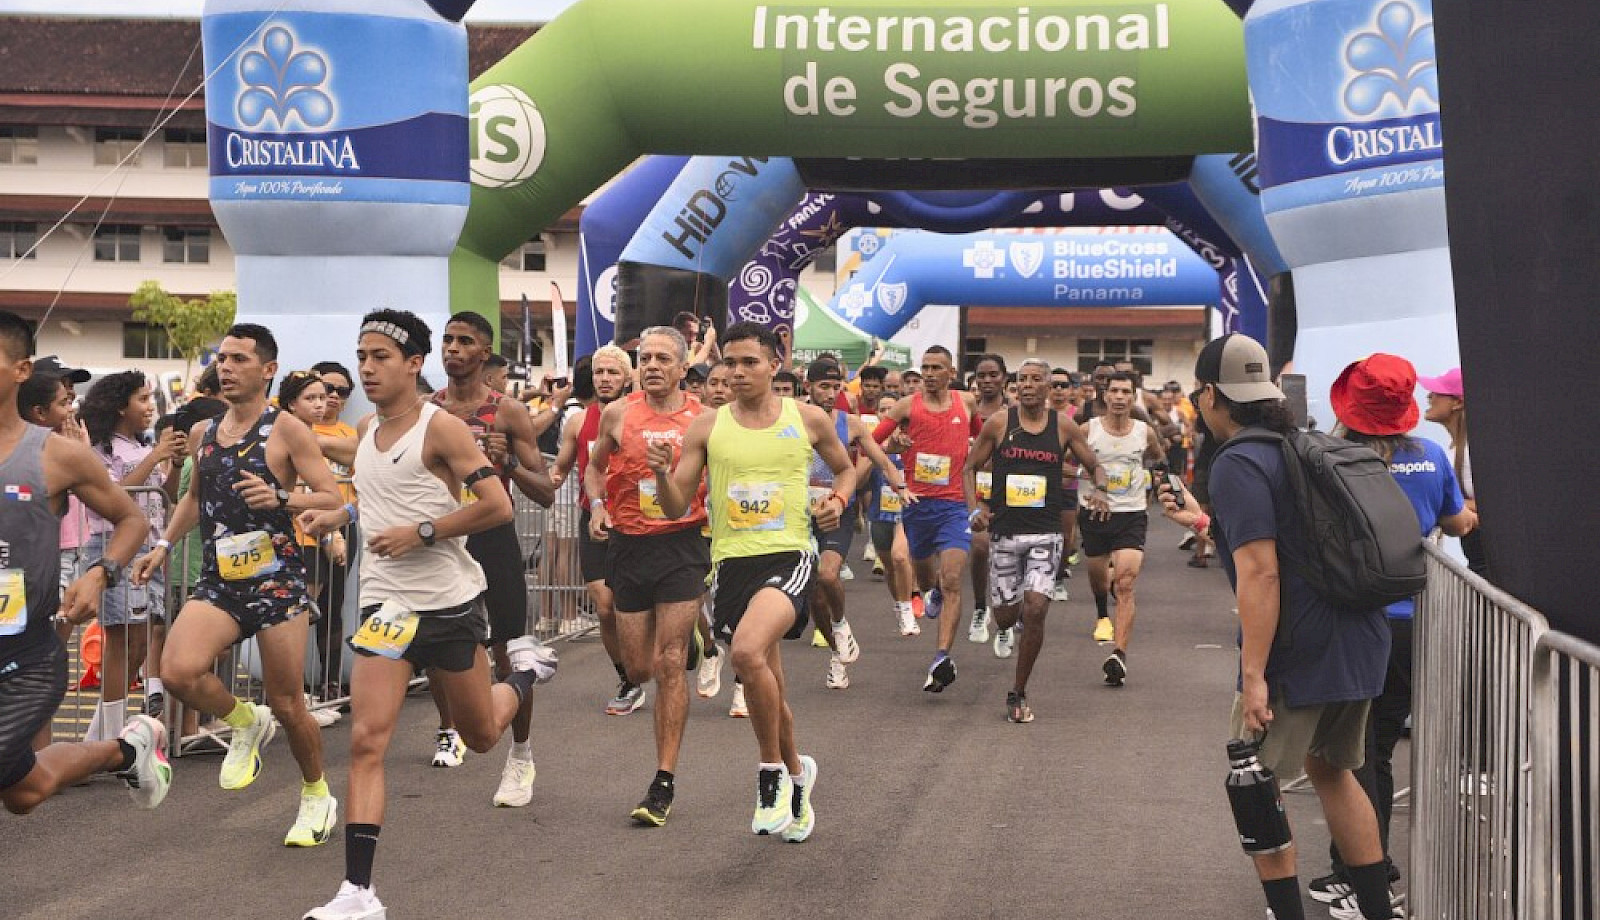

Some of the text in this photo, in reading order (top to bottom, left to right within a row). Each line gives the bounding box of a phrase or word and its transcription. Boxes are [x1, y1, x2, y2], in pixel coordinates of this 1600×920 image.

[753, 4, 1170, 52] Internacional
[783, 61, 1138, 129] de Seguros
[226, 132, 361, 171] CRISTALINA
[1327, 122, 1443, 166] CRISTAL
[258, 181, 290, 195] 100%
[1054, 240, 1168, 257] BlueCross
[1054, 258, 1177, 278] BlueShield
[1055, 284, 1144, 300] Panama
[1015, 485, 1036, 499] 784
[740, 500, 771, 514] 942
[230, 548, 262, 567] 275
[370, 617, 405, 641] 817
